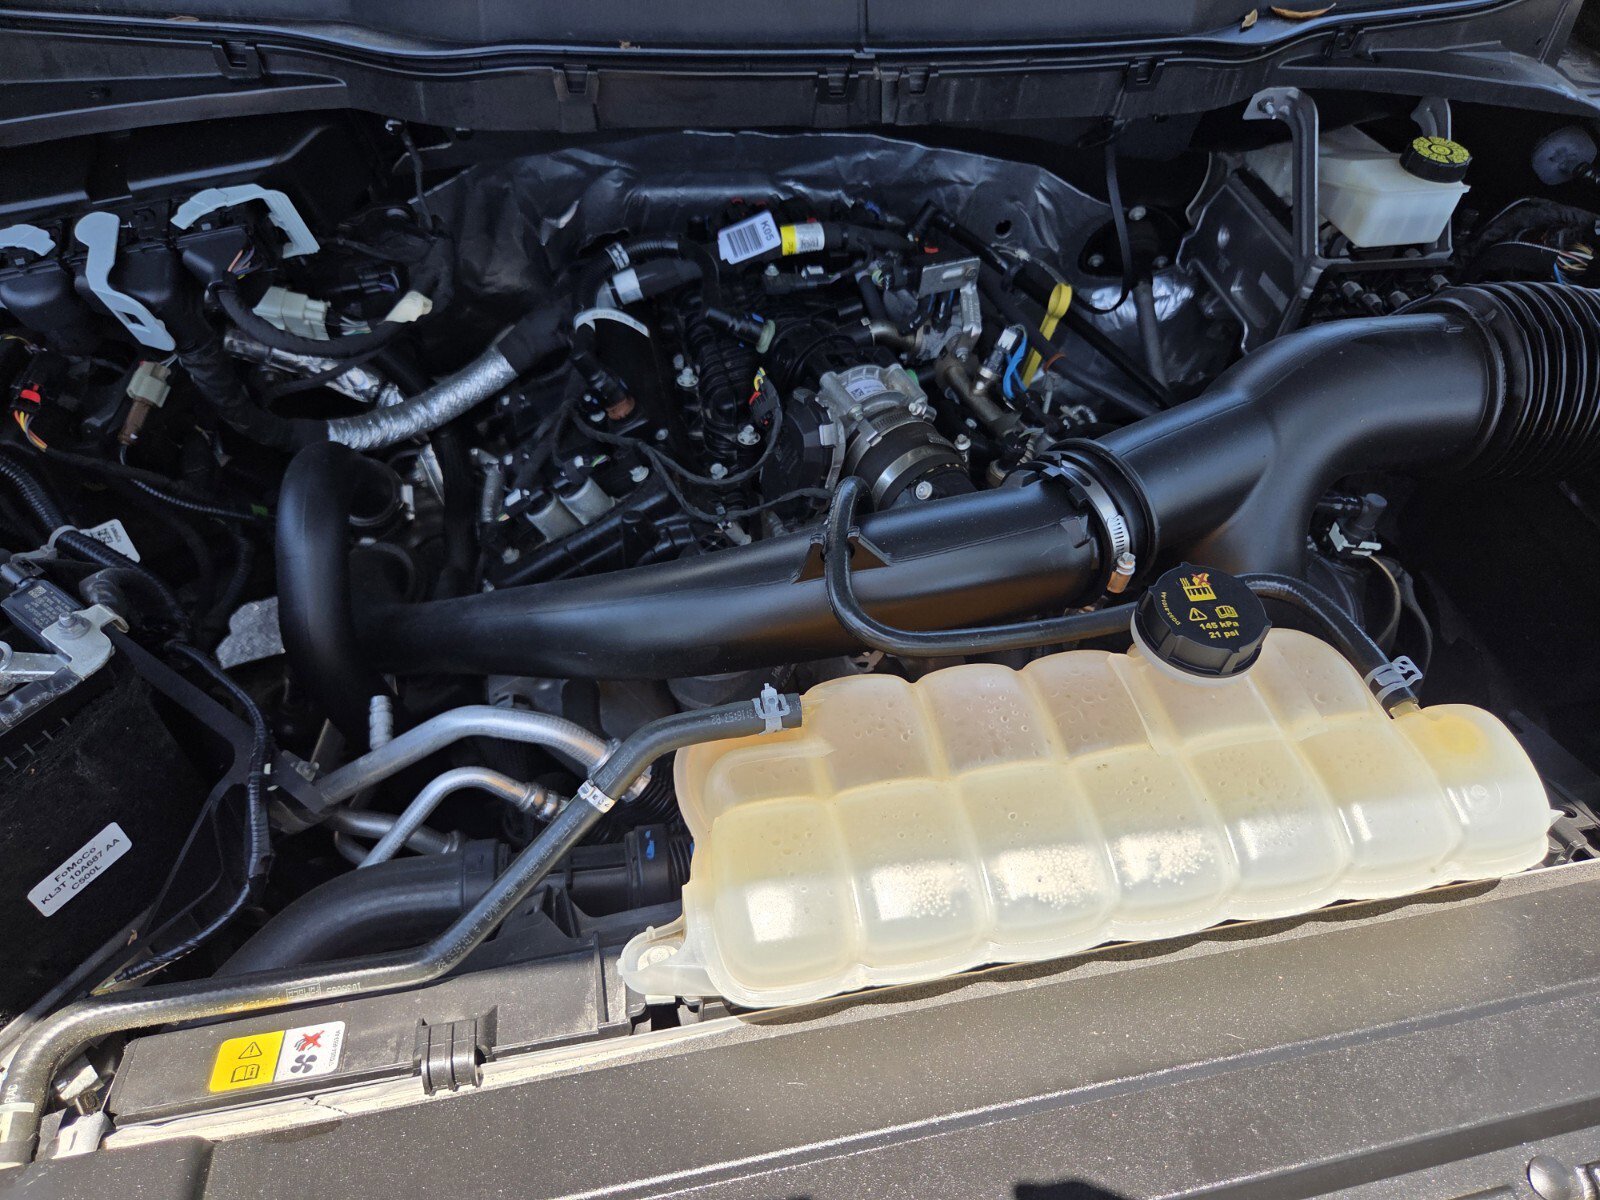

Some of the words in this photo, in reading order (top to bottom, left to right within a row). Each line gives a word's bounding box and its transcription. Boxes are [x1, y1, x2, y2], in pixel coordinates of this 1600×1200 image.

[761, 220, 775, 241] K05
[1200, 622, 1218, 630] 145
[1219, 620, 1239, 628] kPa
[1208, 631, 1221, 639] 21
[41, 881, 68, 905] KL3T
[69, 850, 104, 881] 10A687
[105, 838, 120, 852] AA
[54, 847, 97, 882] FoMoCo
[71, 865, 103, 890] C500L
[4, 1084, 18, 1104] RAD
